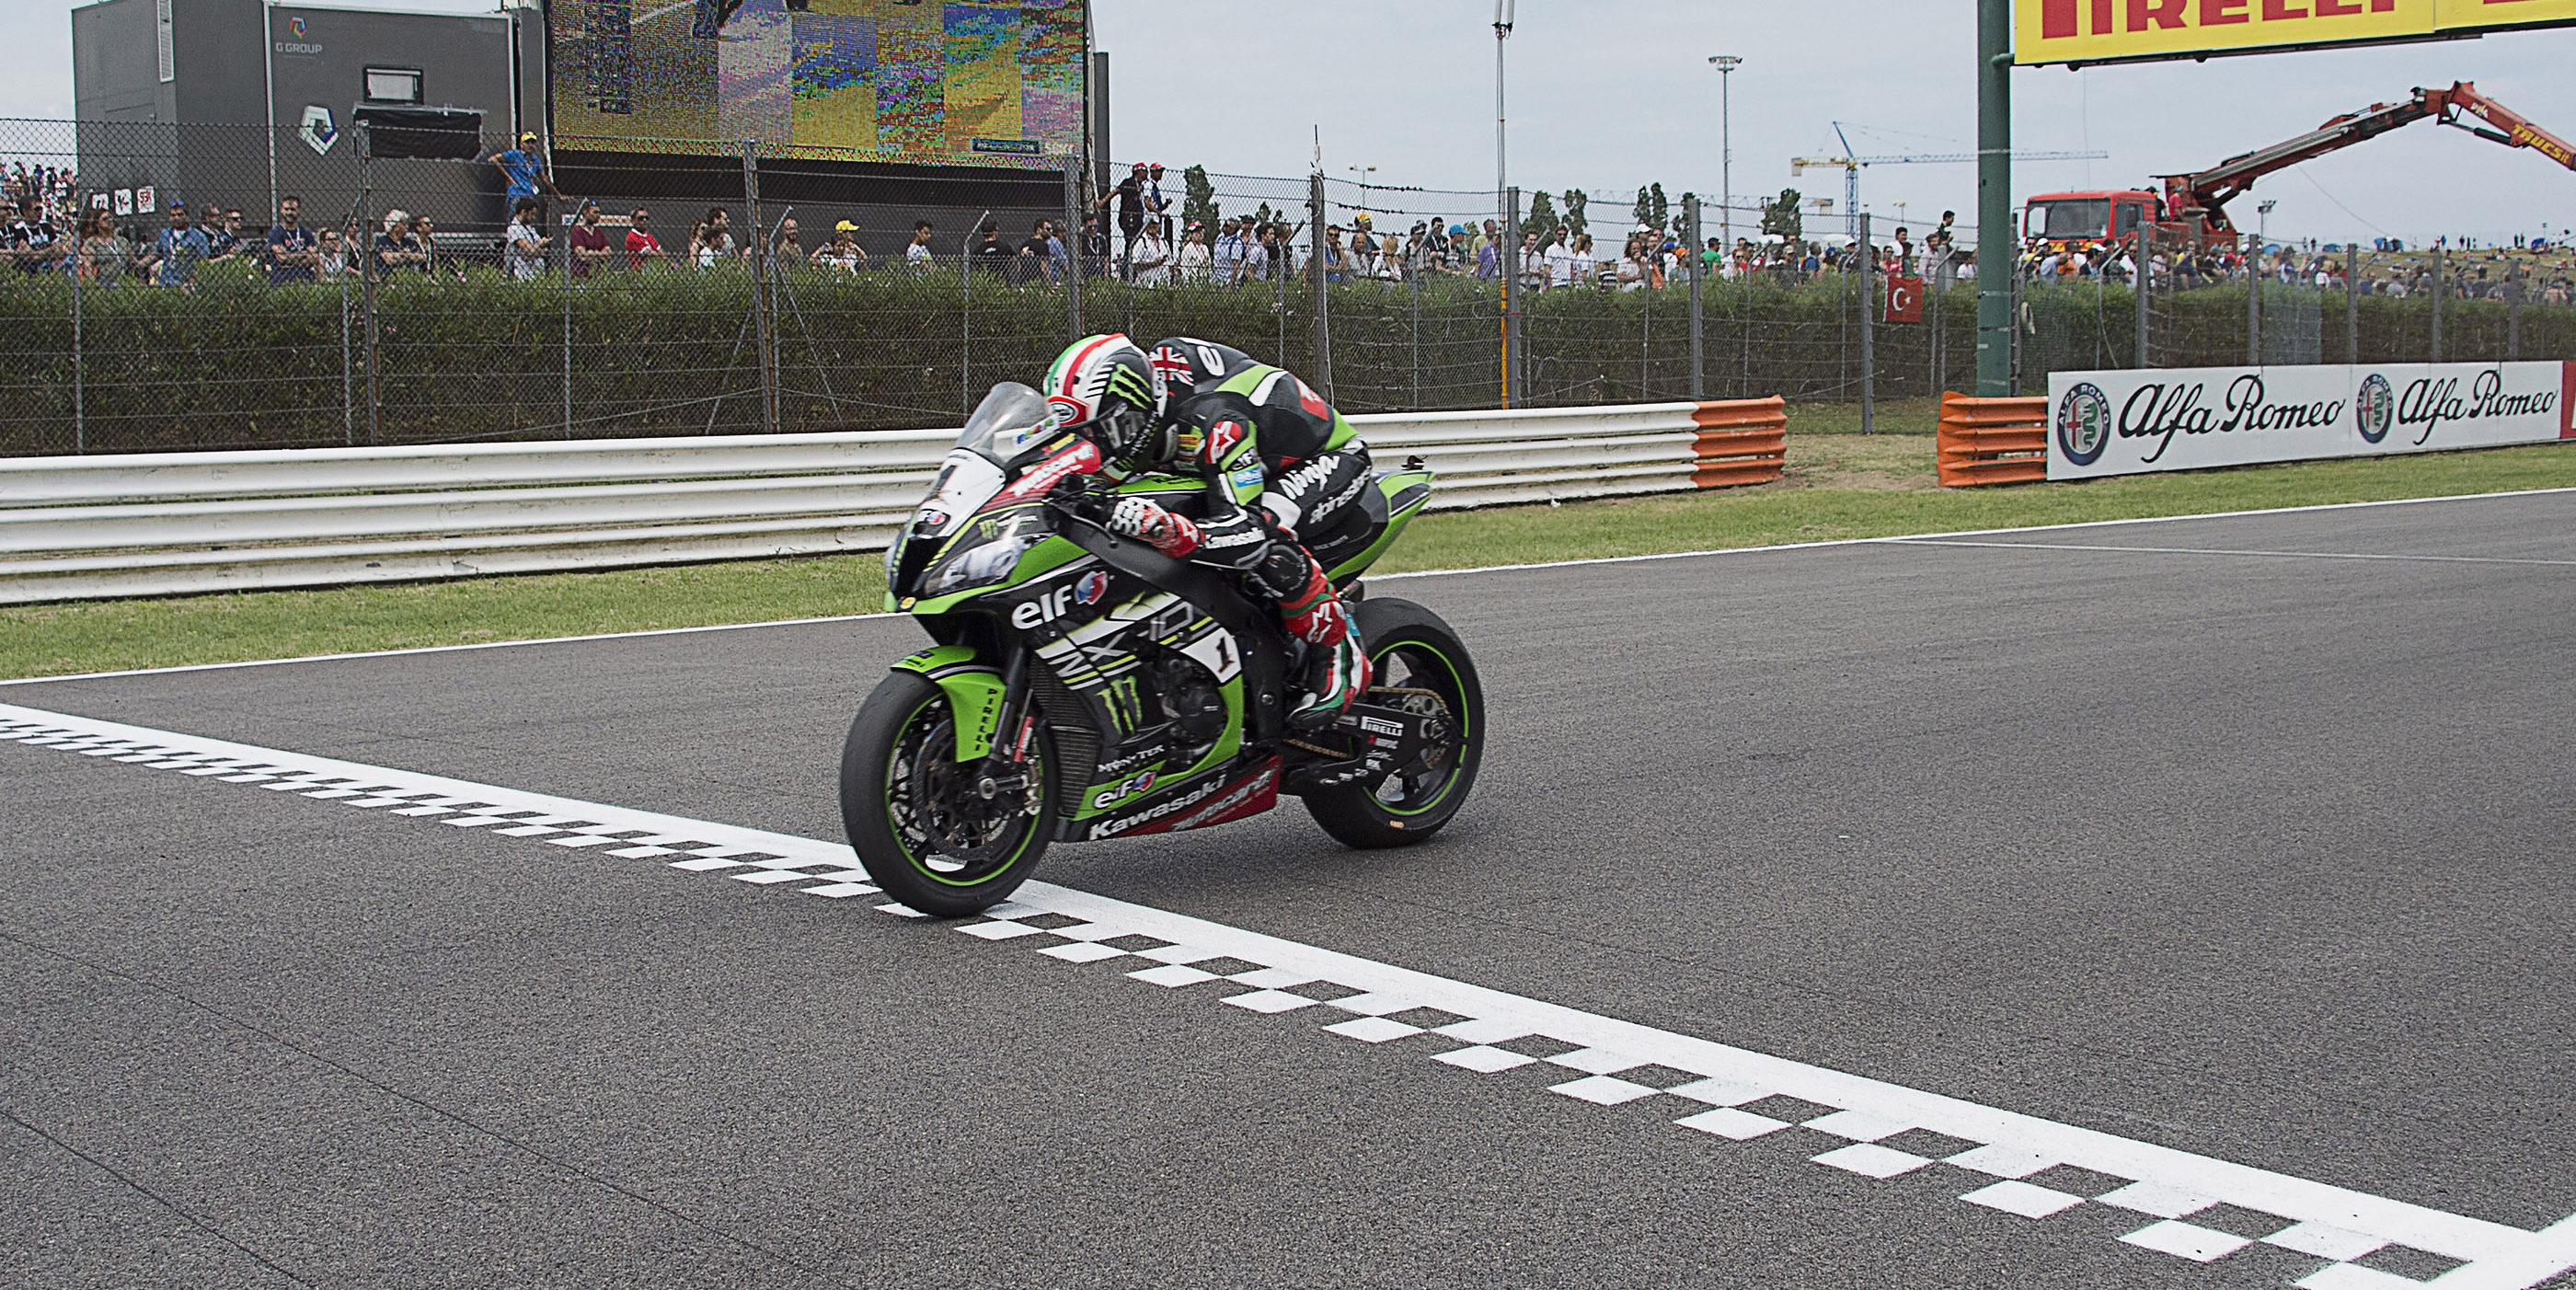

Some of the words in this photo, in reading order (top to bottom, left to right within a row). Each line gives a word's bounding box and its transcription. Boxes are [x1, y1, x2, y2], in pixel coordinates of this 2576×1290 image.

[2042, 0, 2396, 39] IREL
[276, 41, 283, 52] G
[285, 42, 323, 54] GROUP
[2081, 385, 2110, 425] ROMEO
[2118, 383, 2220, 463] Alfa
[2218, 374, 2346, 432] Romeo
[2398, 377, 2467, 445] Alfa
[2468, 369, 2559, 418] Romeo
[1278, 455, 1340, 501] Ninja
[1012, 584, 1073, 629] elf
[1216, 635, 1236, 674] 1
[974, 687, 998, 752] PIRELLI
[1361, 716, 1404, 736] PIRELLI
[1089, 774, 1227, 841] Kawasaki
[1094, 779, 1133, 808] elf
